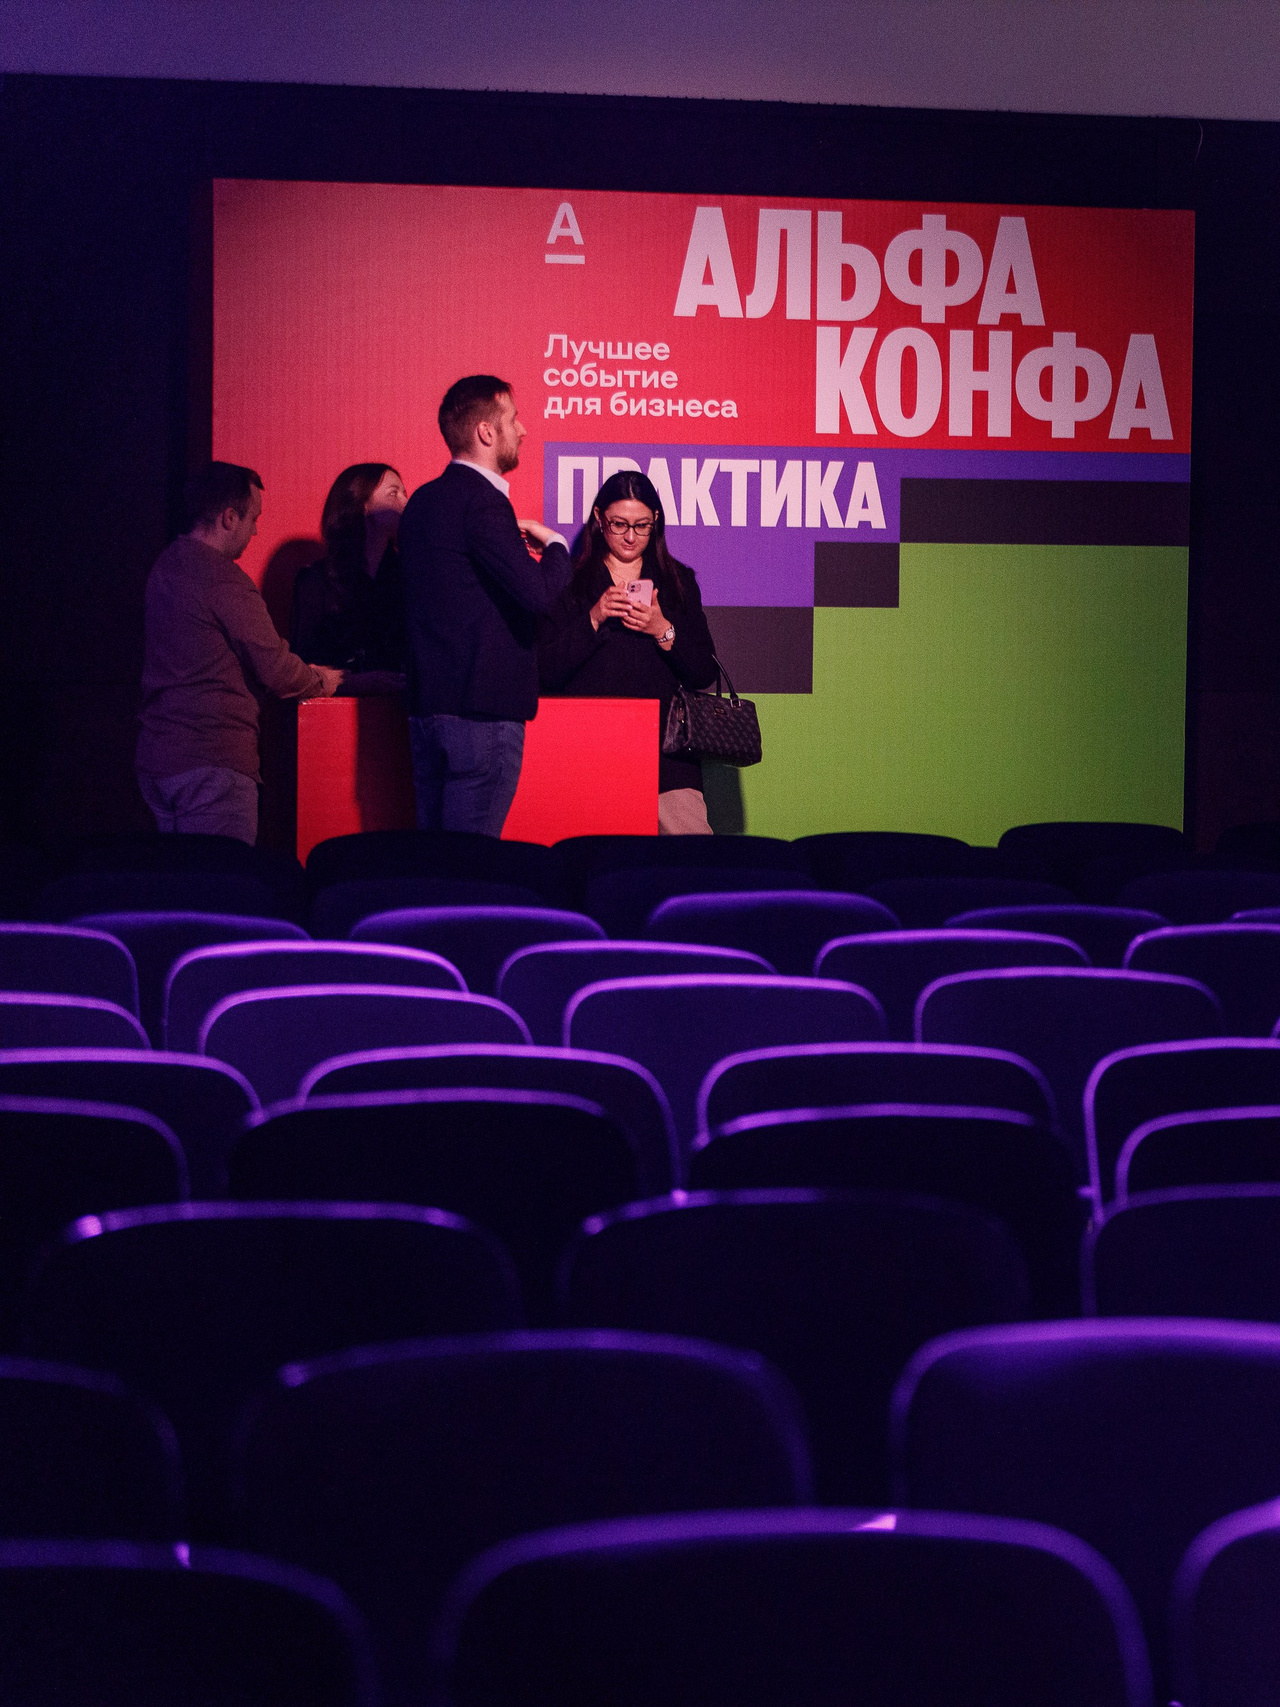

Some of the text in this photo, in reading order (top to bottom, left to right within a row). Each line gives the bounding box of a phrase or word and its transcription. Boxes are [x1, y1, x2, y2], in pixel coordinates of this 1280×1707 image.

[673, 206, 1046, 326] АЛЬФА
[544, 333, 671, 365] Лучшее
[543, 362, 679, 389] событие
[814, 325, 1174, 440] КОНФА
[544, 391, 739, 419] для бизнеса
